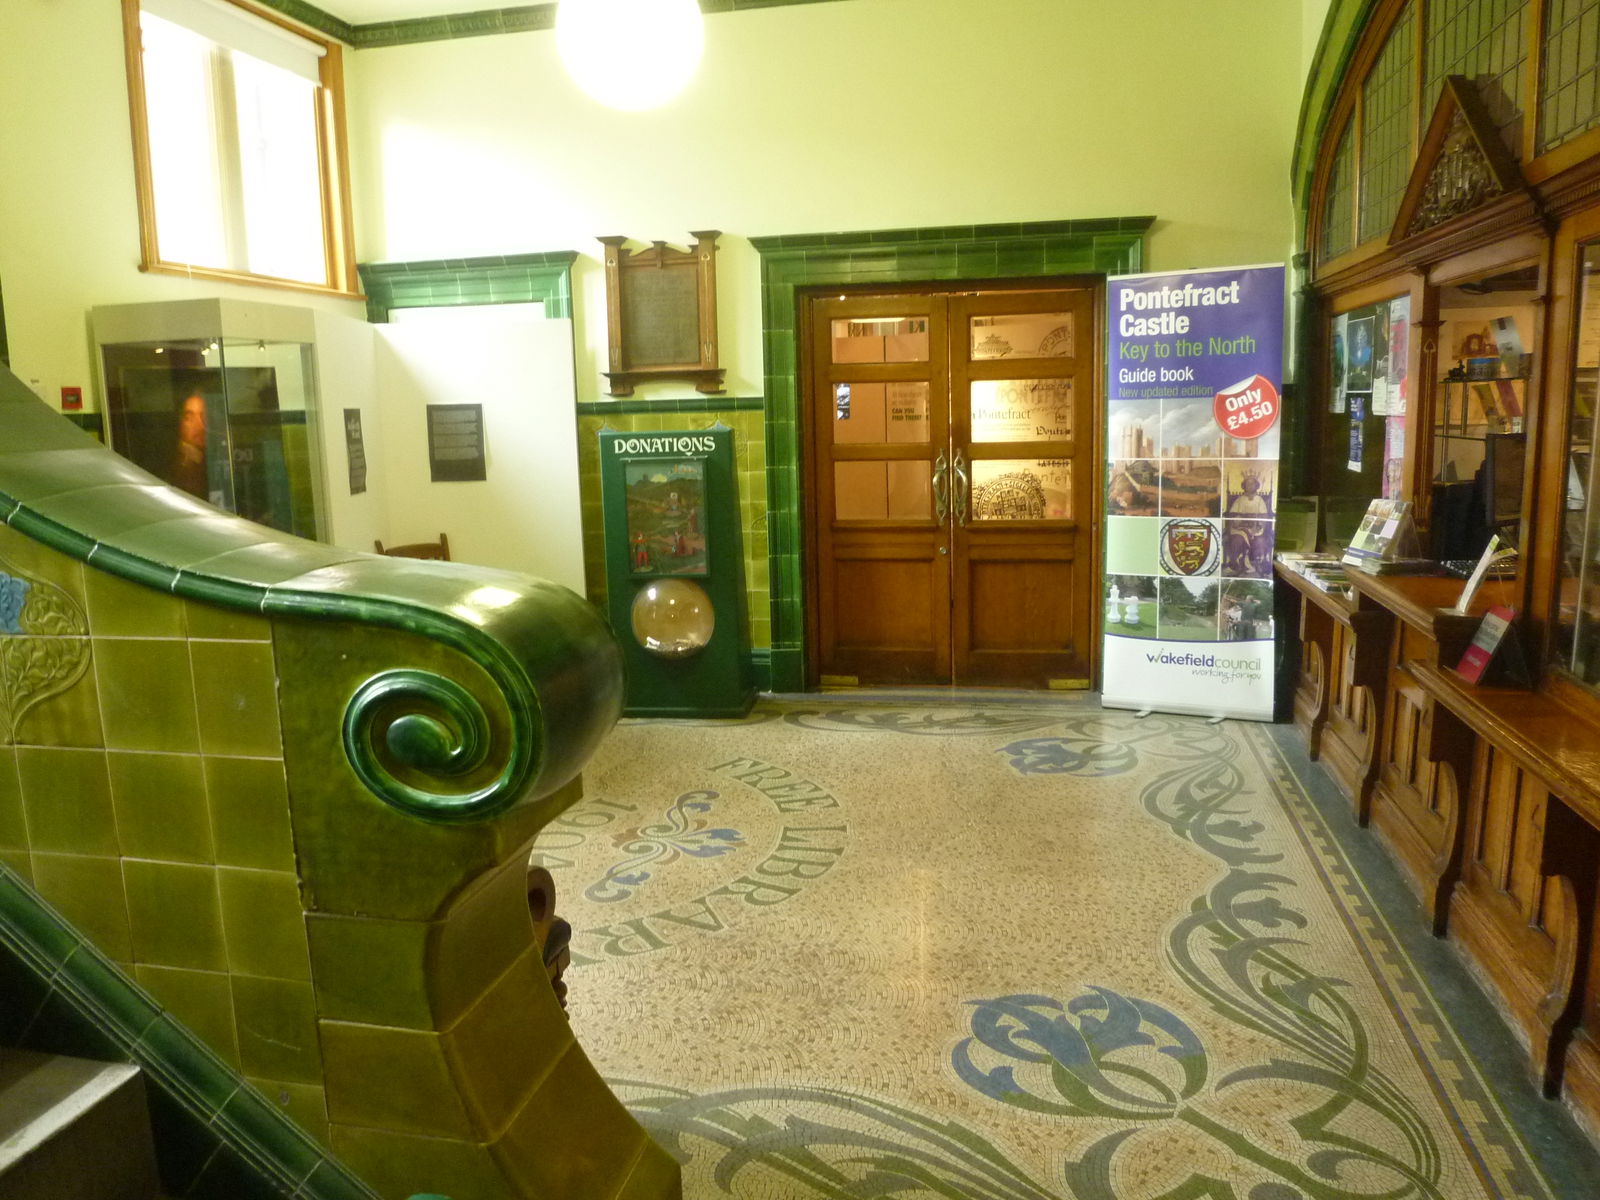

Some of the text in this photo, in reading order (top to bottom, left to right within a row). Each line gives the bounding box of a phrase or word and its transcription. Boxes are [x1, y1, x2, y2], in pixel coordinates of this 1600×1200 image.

[1119, 281, 1240, 311] Pontefract
[1119, 312, 1190, 337] Castle
[1119, 335, 1257, 363] Key to the North
[1118, 366, 1195, 384] Guide book
[1118, 385, 1214, 401] New updated edition
[1224, 387, 1263, 412] Only
[1226, 401, 1274, 430] £4.50
[613, 436, 716, 455] DONATIONS
[707, 756, 841, 814] FREE
